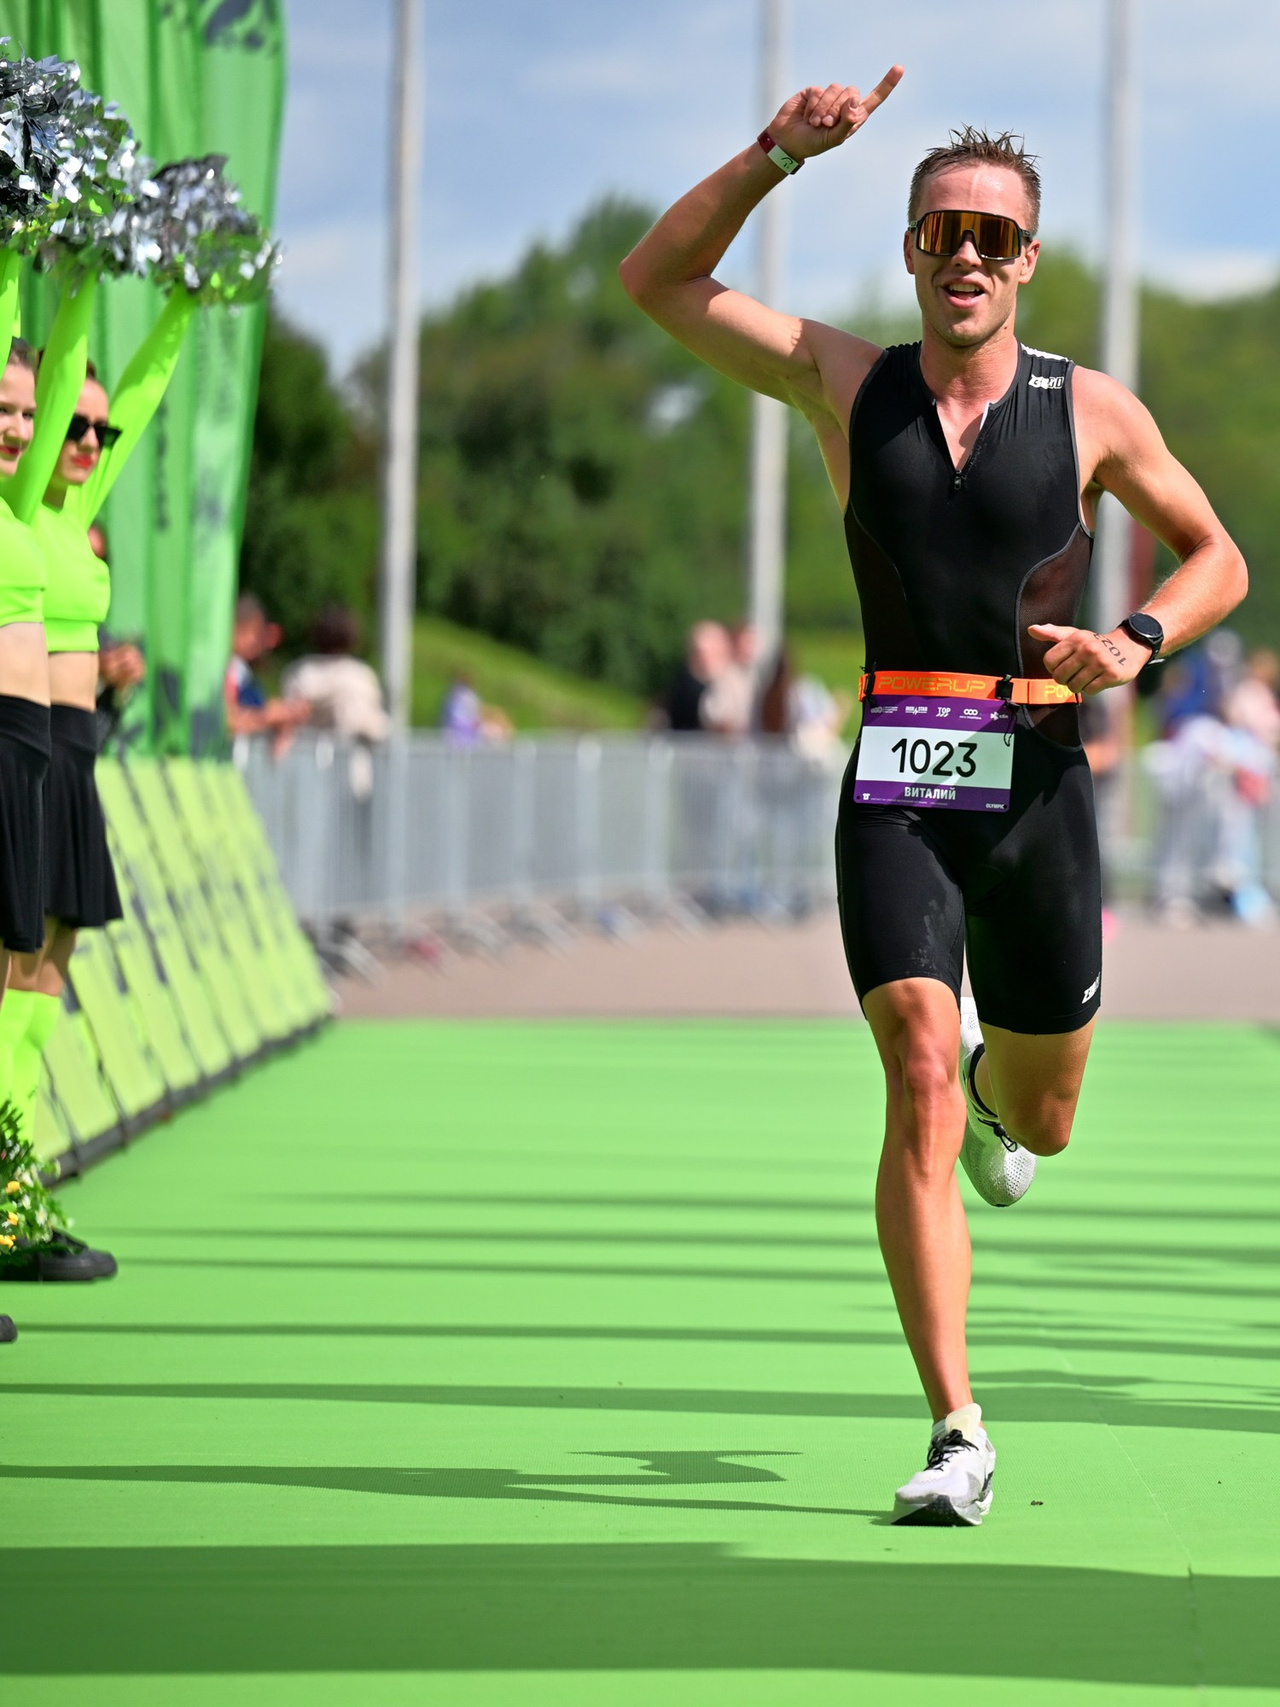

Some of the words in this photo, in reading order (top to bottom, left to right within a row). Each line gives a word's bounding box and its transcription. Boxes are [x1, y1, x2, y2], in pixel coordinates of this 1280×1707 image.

[878, 676, 986, 693] POWERUP
[891, 738, 978, 778] 1023
[904, 786, 956, 800] ВИТАЛИЙ
